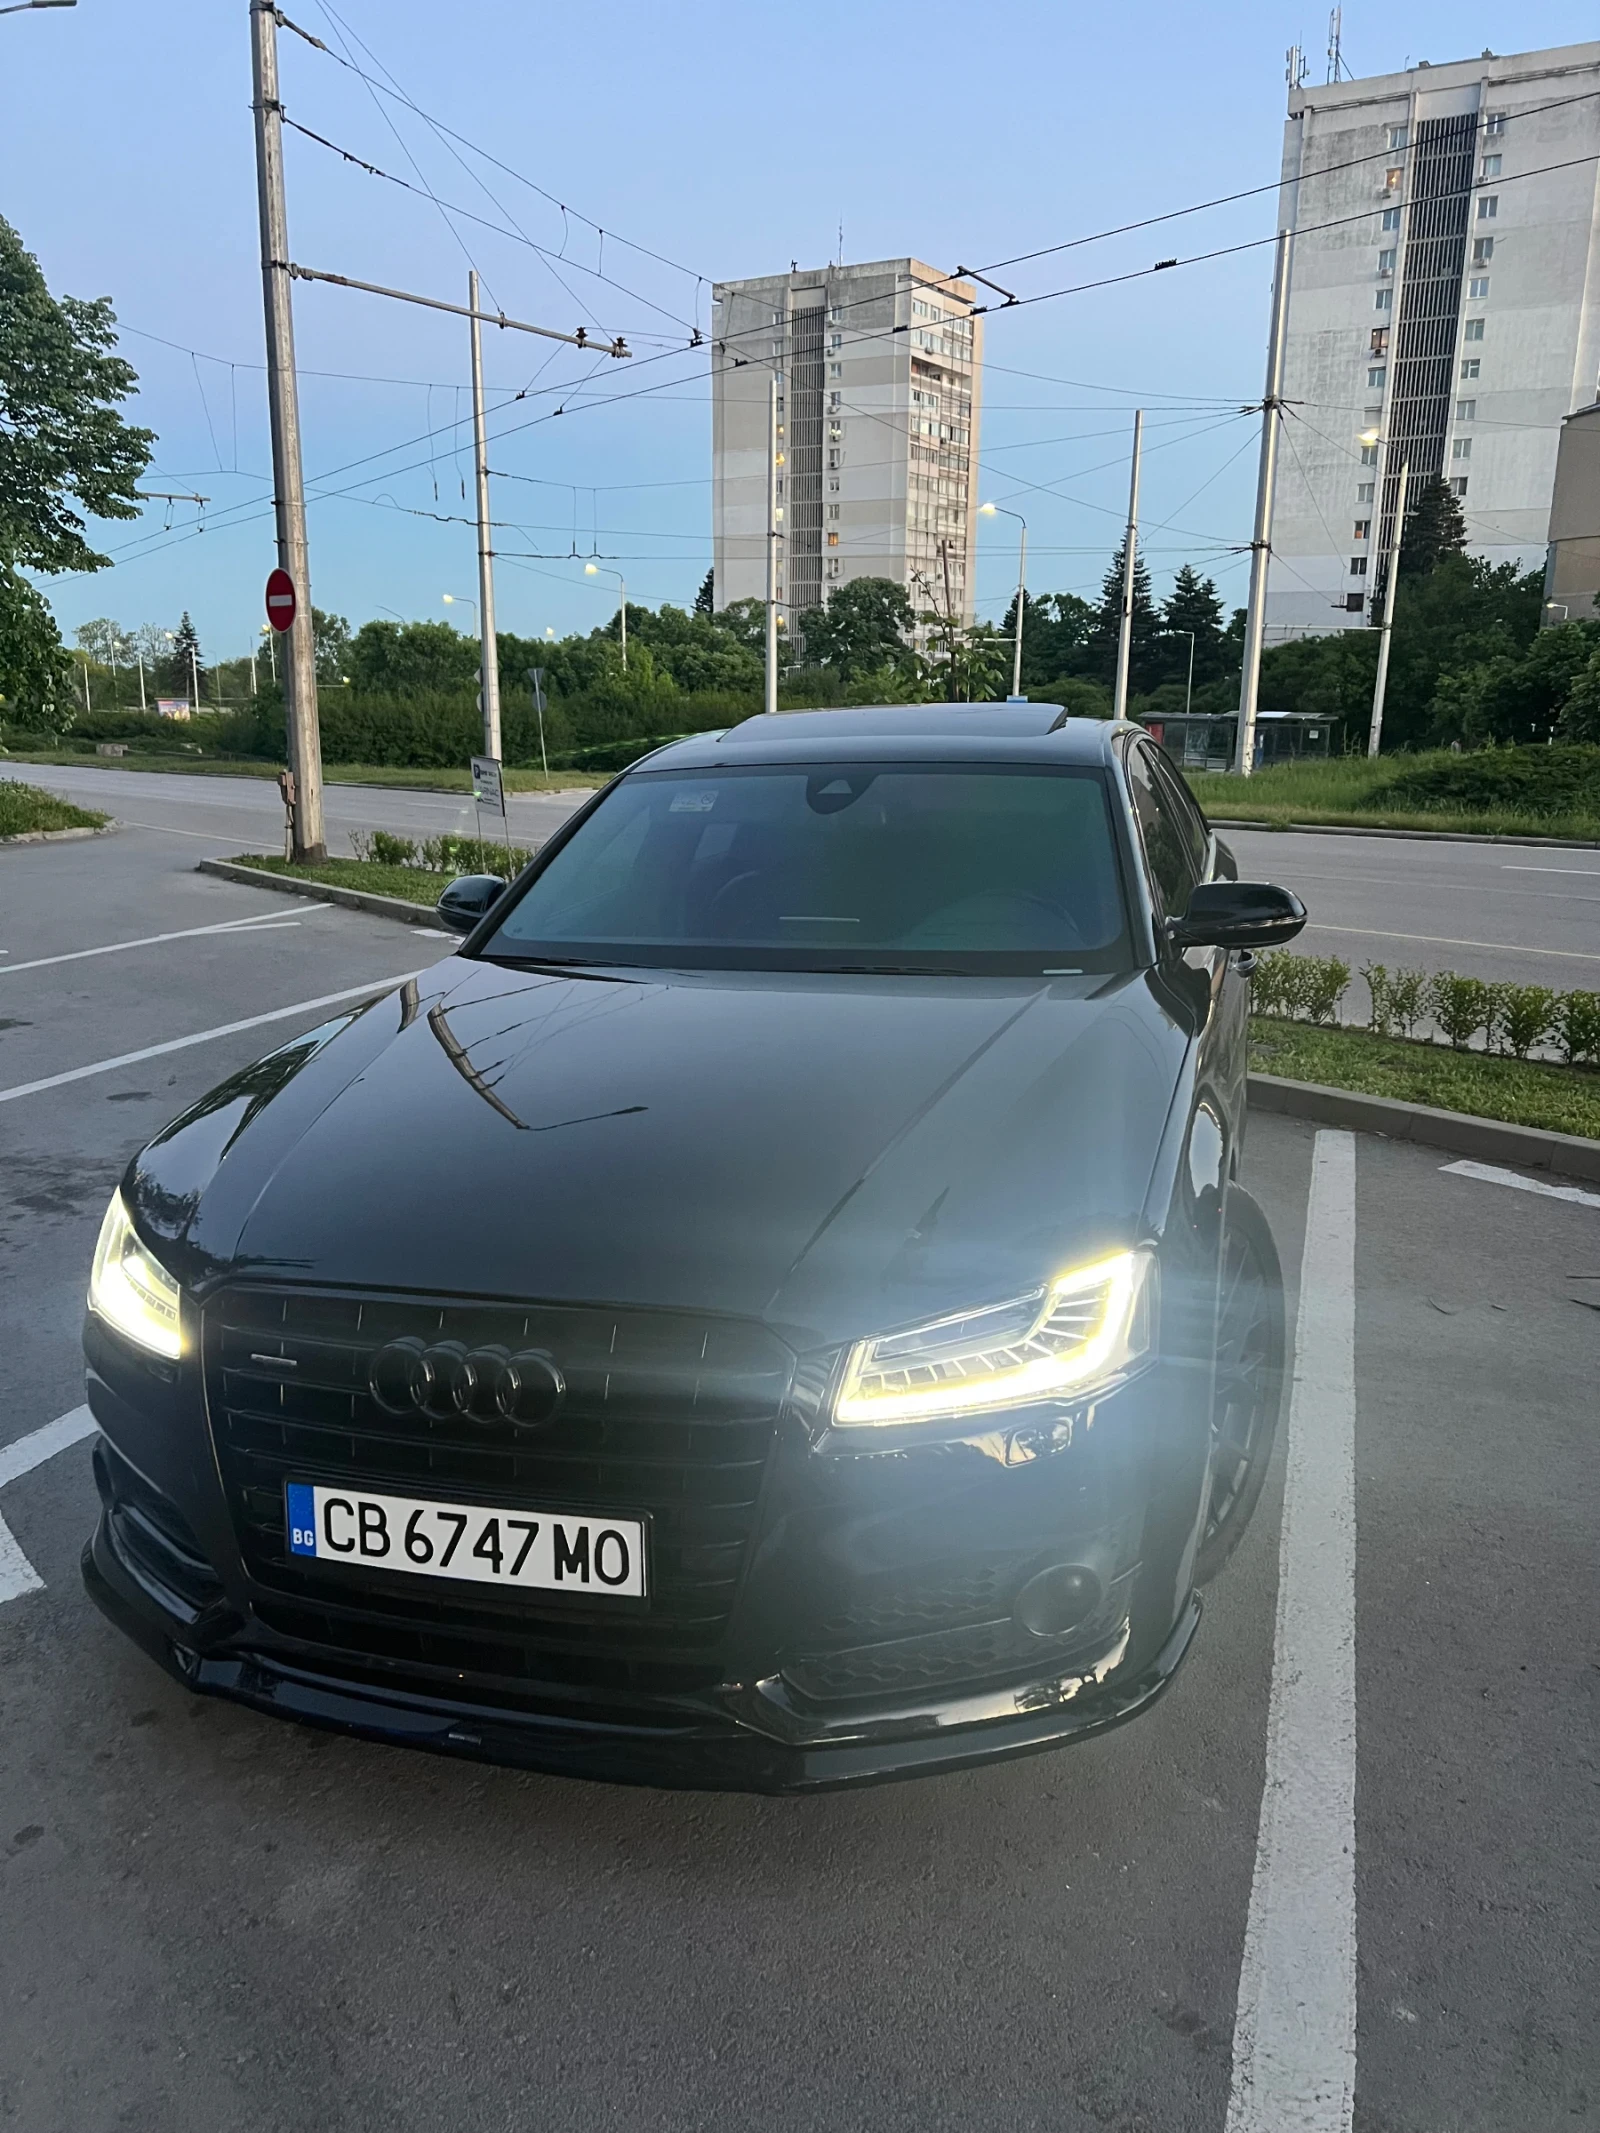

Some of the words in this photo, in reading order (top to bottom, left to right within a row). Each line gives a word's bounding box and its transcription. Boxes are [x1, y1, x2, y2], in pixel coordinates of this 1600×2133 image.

[293, 1527, 314, 1547] BG
[323, 1497, 391, 1557] CB
[404, 1509, 540, 1576] 6747
[553, 1523, 630, 1586] MO
